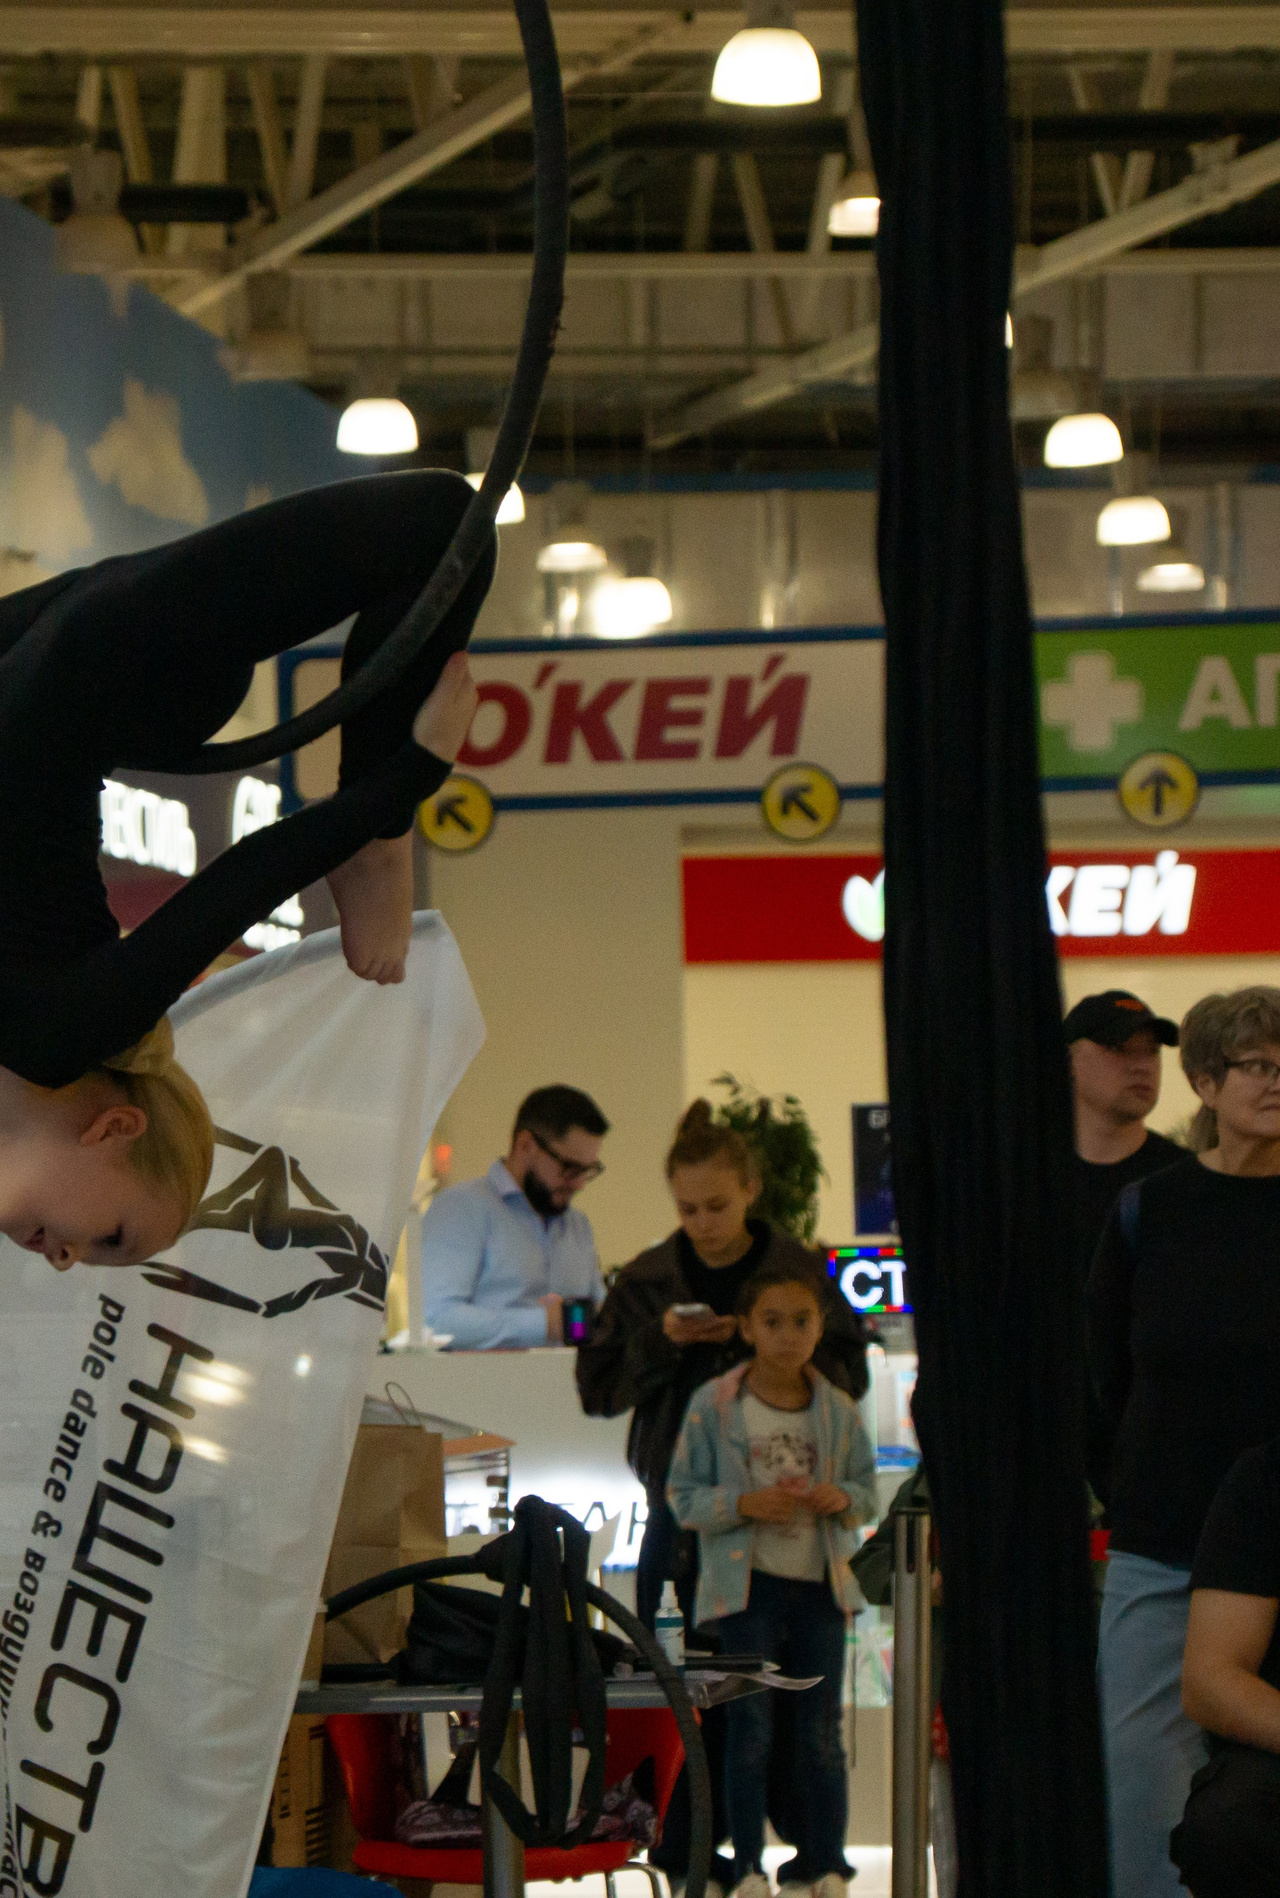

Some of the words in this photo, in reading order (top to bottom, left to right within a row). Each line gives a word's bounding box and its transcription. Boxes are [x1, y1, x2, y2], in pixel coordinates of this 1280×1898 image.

[1045, 850, 1198, 938] КЕЙ
[81, 1293, 125, 1380] pole
[42, 1388, 108, 1503] dance
[30, 1510, 62, 1539] &
[16, 1322, 215, 1898] НАШЕСТВ
